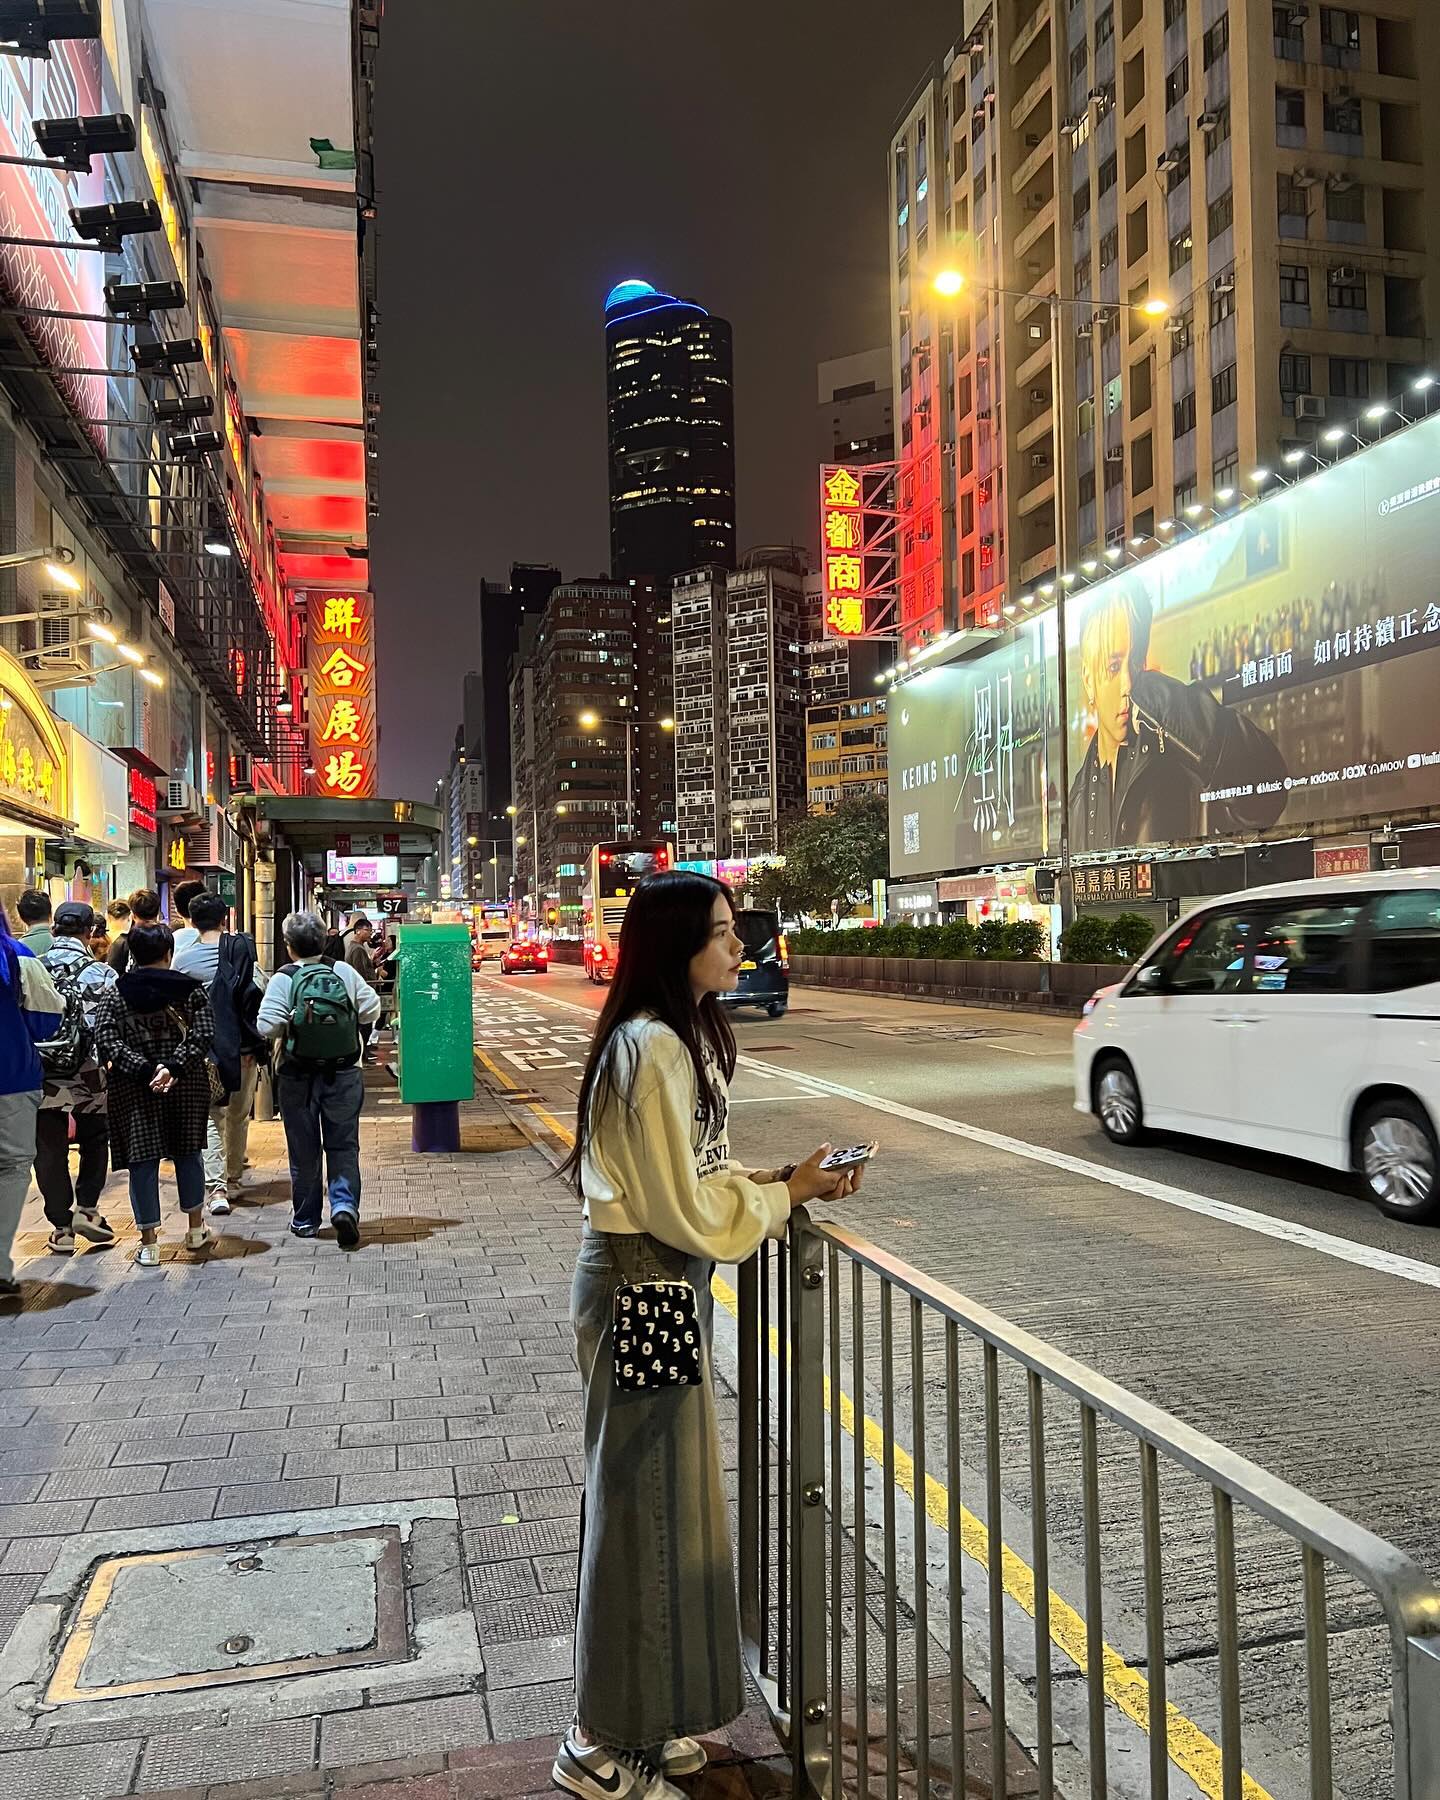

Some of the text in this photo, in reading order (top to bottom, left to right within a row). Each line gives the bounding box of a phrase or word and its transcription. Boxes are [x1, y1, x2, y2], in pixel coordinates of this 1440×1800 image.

[1226, 603, 1440, 688] 一體兩面 如何持續正念
[321, 597, 366, 793] 聯合廣場
[902, 753, 958, 791] KEUNG TO
[1341, 764, 1367, 780] JOOX
[1380, 760, 1404, 772] MOOV
[1263, 780, 1282, 793] Music
[1074, 866, 1131, 893] 嘉嘉藥房
[1074, 891, 1138, 902] PHARMACY LIMITED
[383, 899, 401, 912] S7
